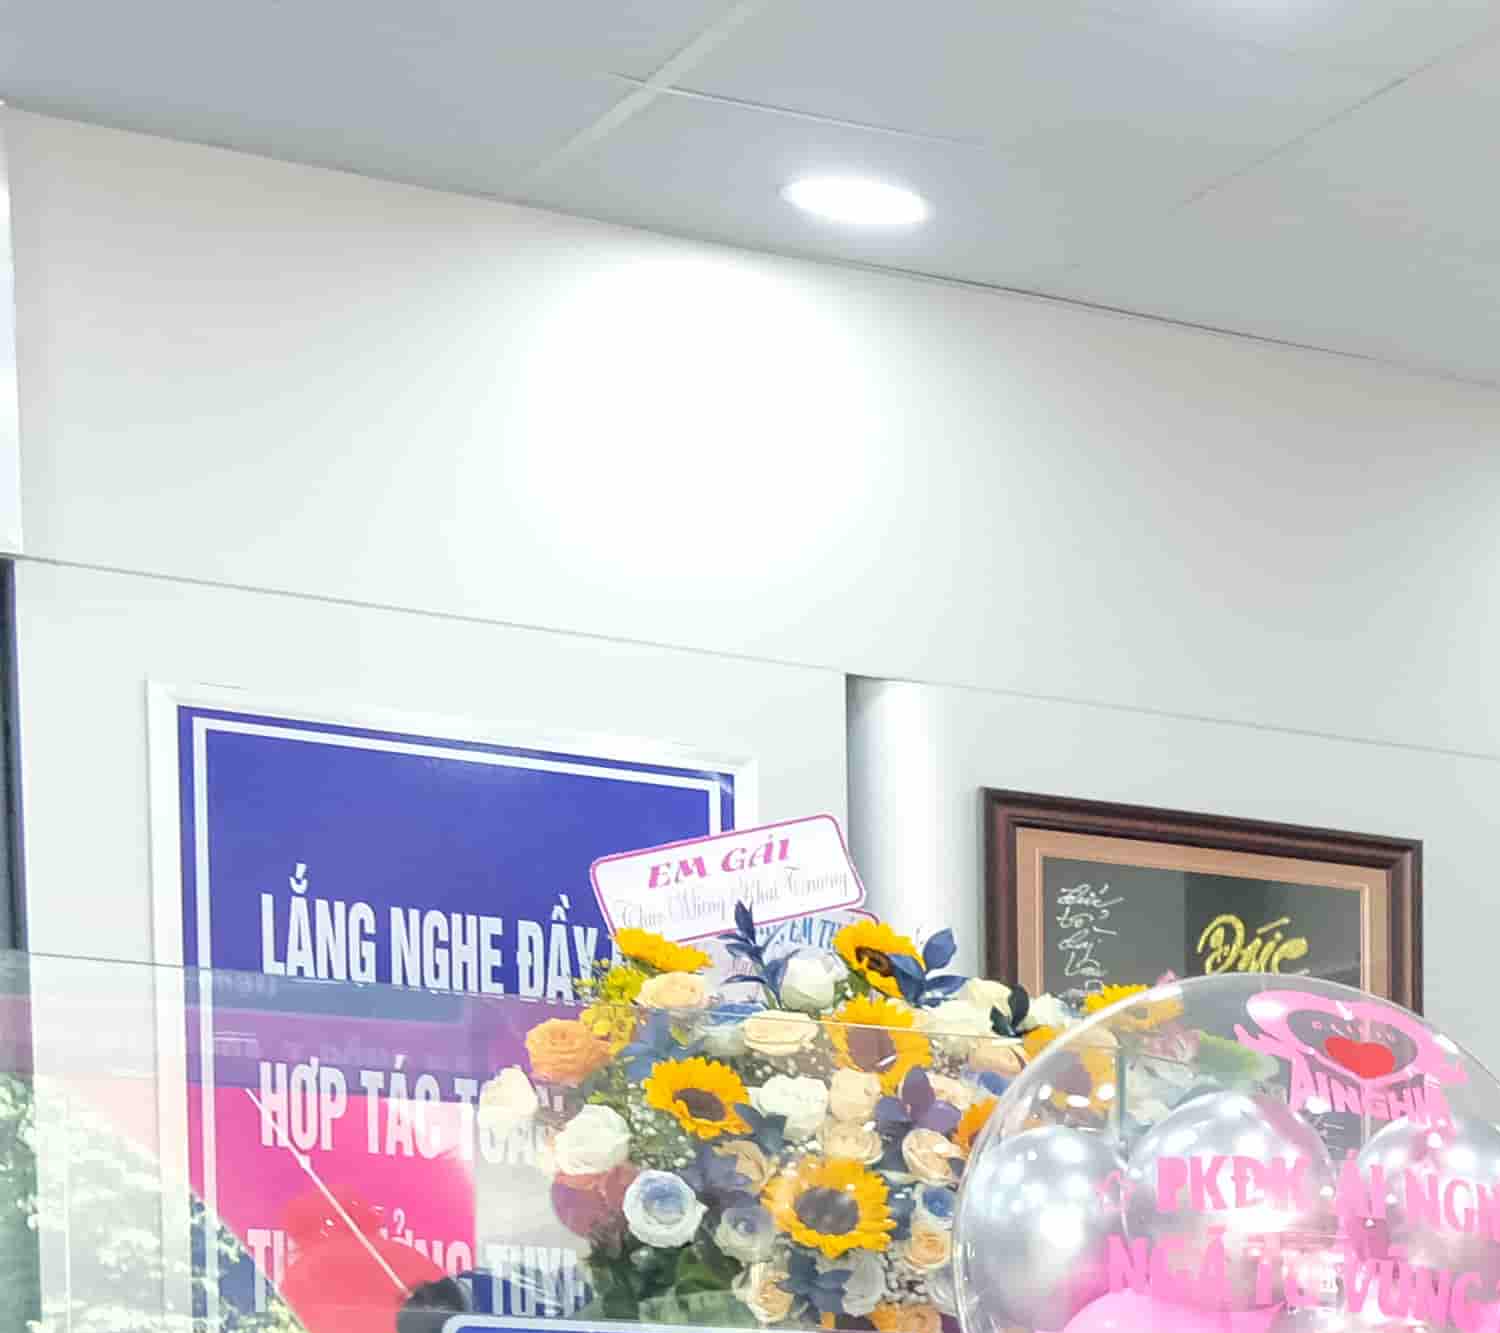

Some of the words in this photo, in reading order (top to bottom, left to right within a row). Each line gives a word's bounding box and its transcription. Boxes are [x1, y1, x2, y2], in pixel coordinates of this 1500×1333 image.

[646, 856, 709, 889] EM
[720, 834, 791, 873] GÁI
[260, 862, 377, 985] LẮNG
[390, 905, 505, 995] NGHE
[516, 893, 599, 1006] ĐẦY
[258, 1056, 347, 1163] HỢP
[359, 1054, 443, 1159] TÁC
